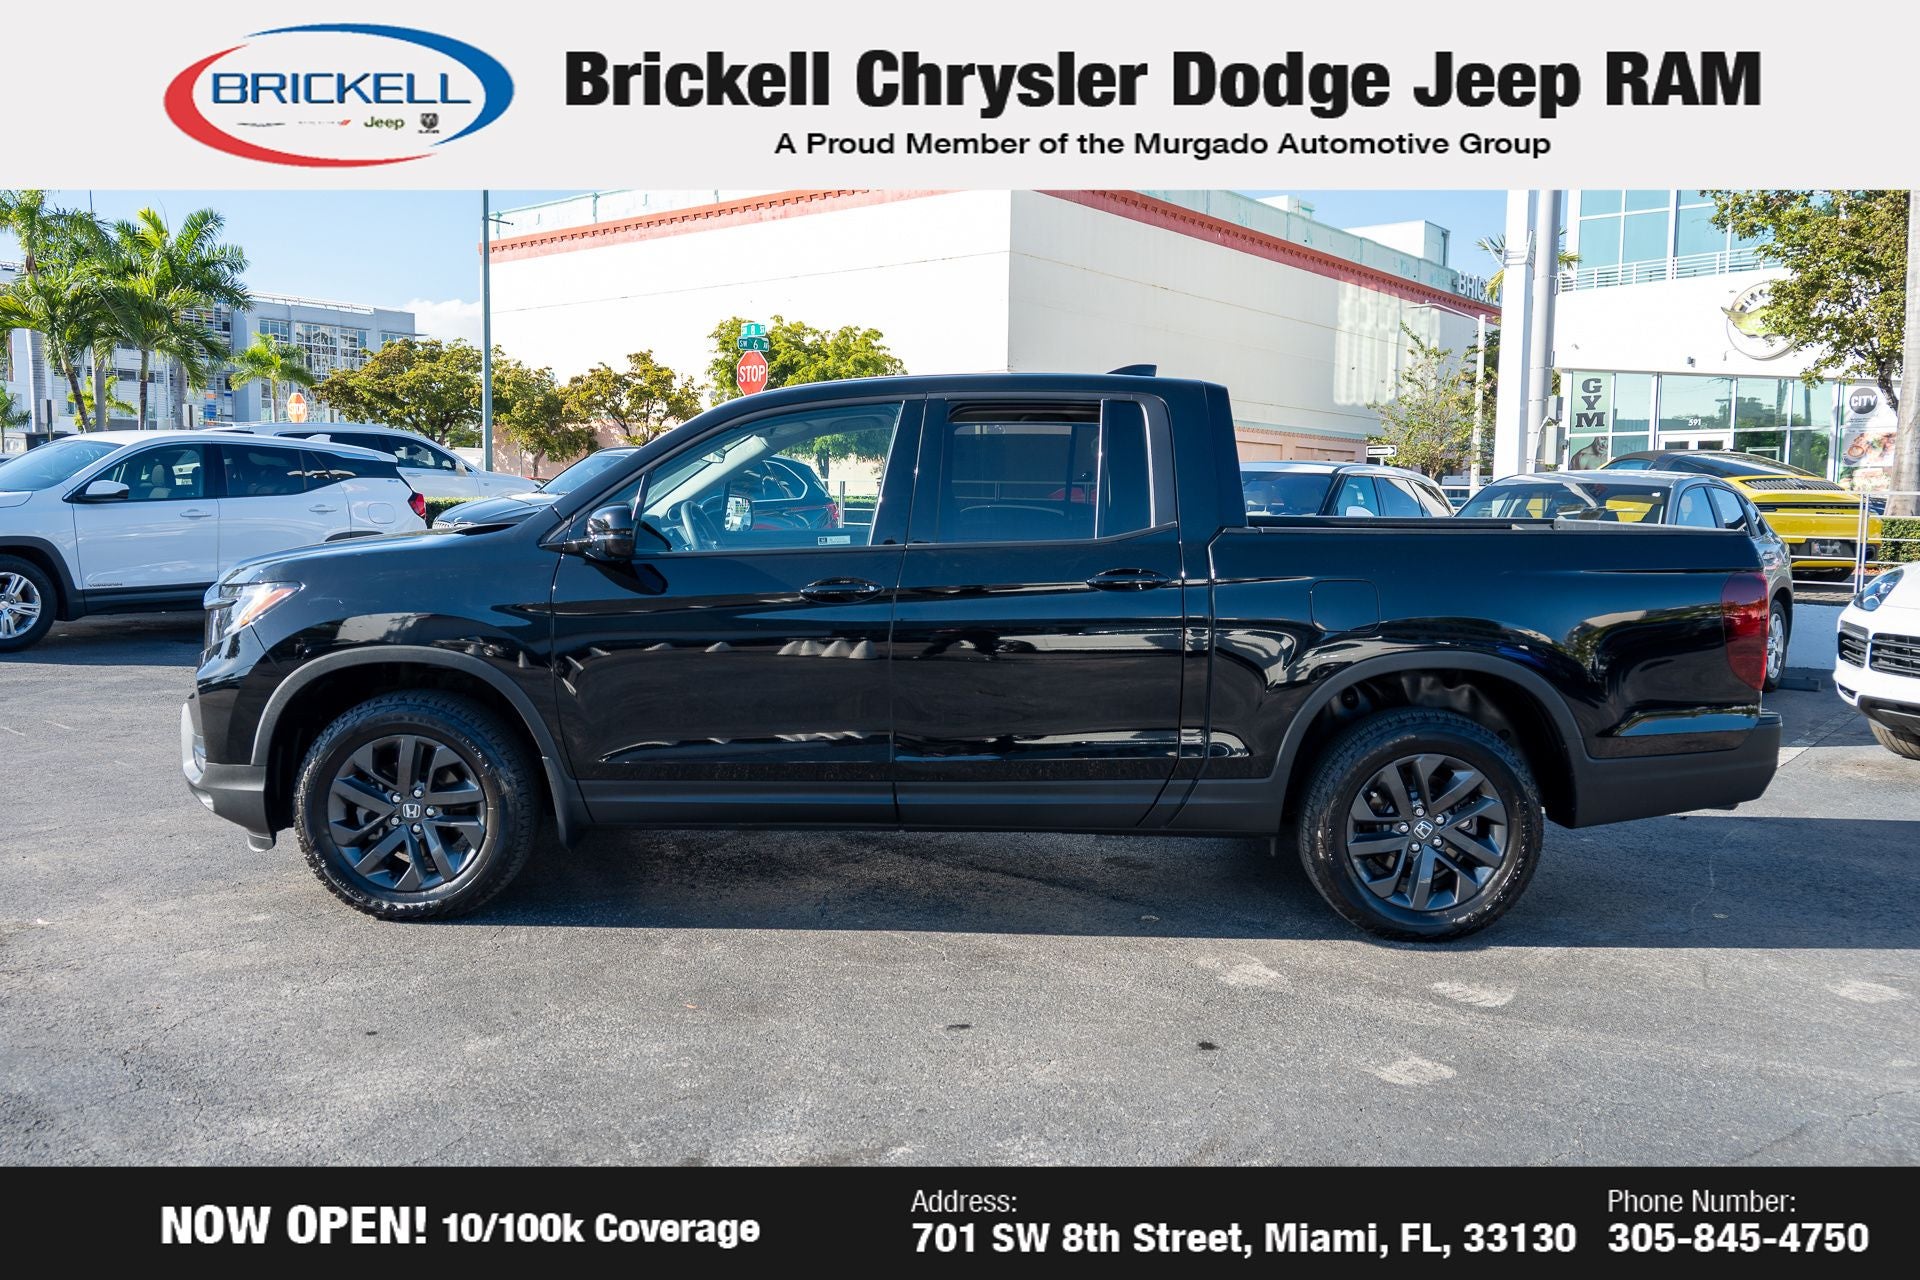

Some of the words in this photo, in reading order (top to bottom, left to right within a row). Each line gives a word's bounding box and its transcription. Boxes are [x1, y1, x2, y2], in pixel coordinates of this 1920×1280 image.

[753, 339, 759, 349] 6
[739, 365, 765, 382] STOP
[1575, 378, 1605, 427] GYM
[1851, 395, 1876, 406] CITY
[288, 403, 305, 415] STOP
[1688, 418, 1702, 427] 591
